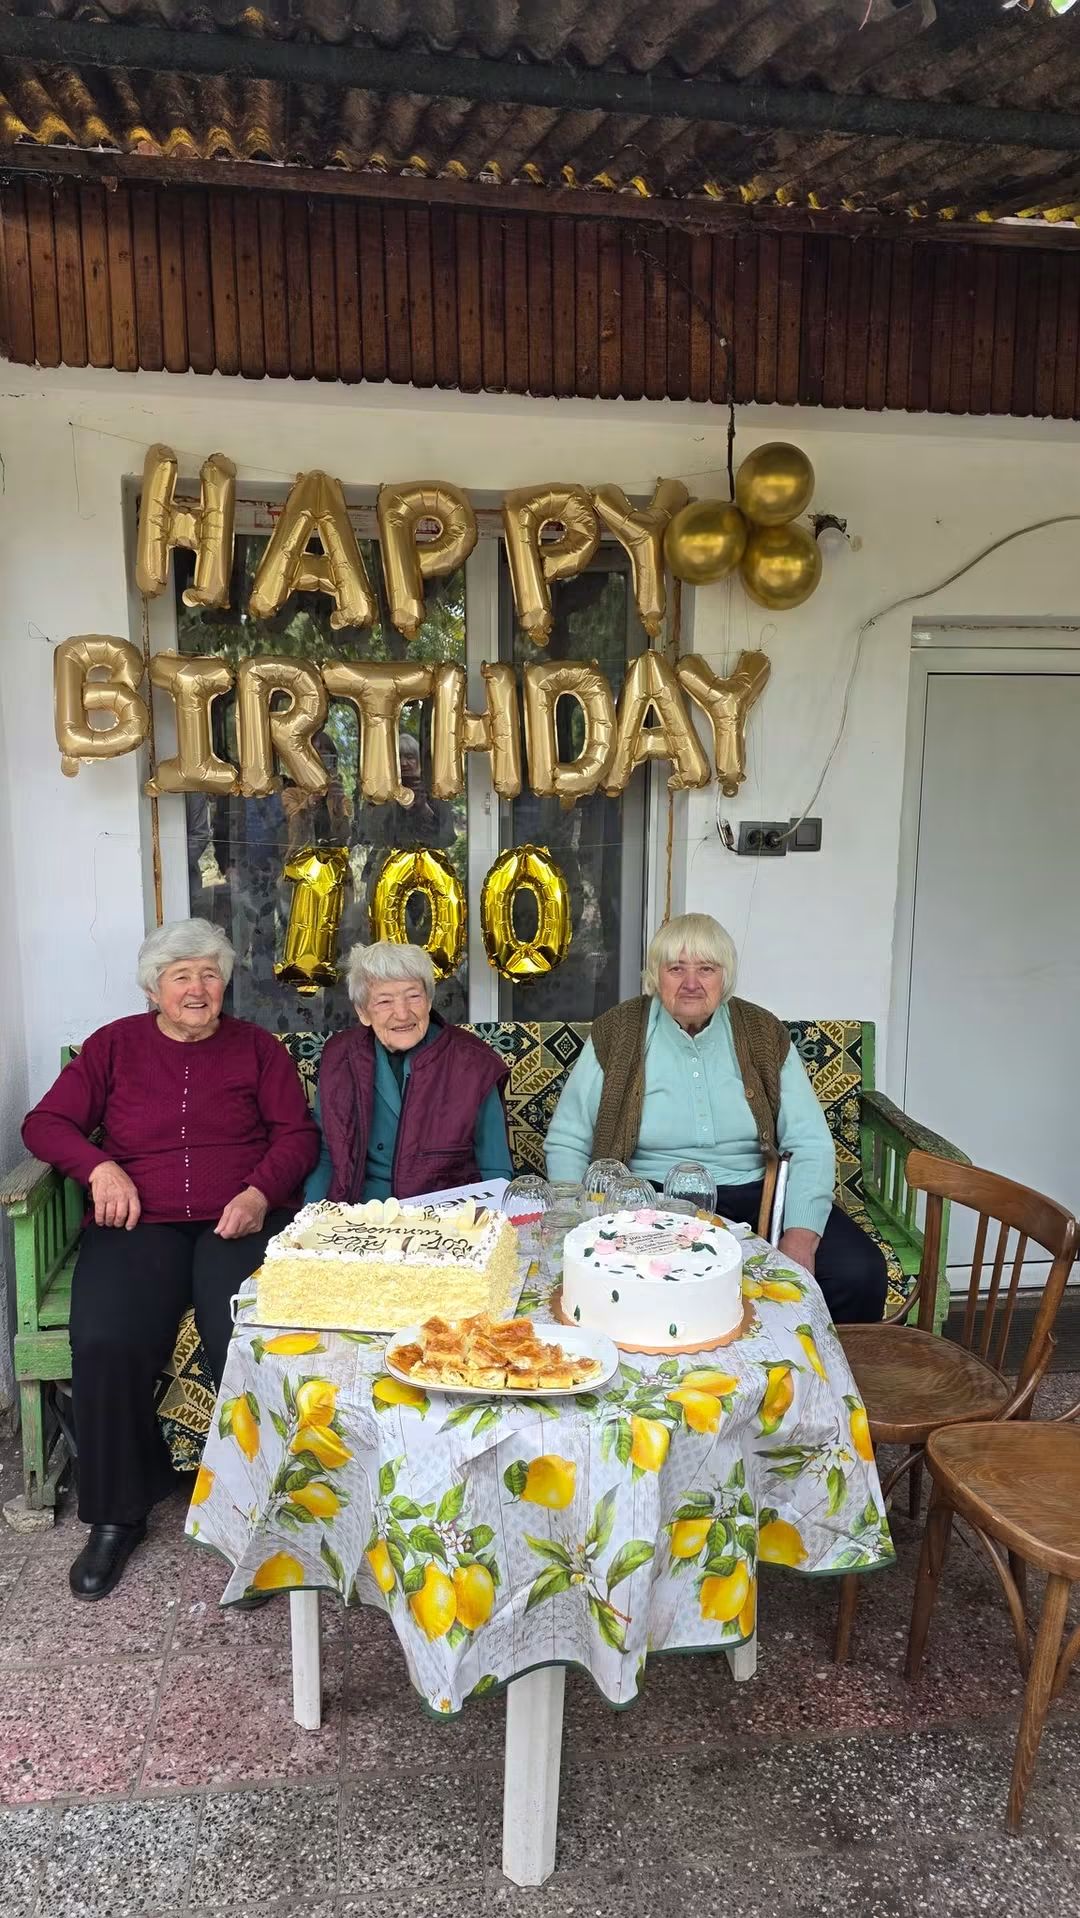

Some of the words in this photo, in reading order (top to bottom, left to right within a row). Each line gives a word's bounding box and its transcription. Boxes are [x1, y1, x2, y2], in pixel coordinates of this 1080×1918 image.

[134, 443, 691, 646] HAPPY
[53, 634, 771, 807] BIRTHDAY
[273, 843, 573, 997] 100
